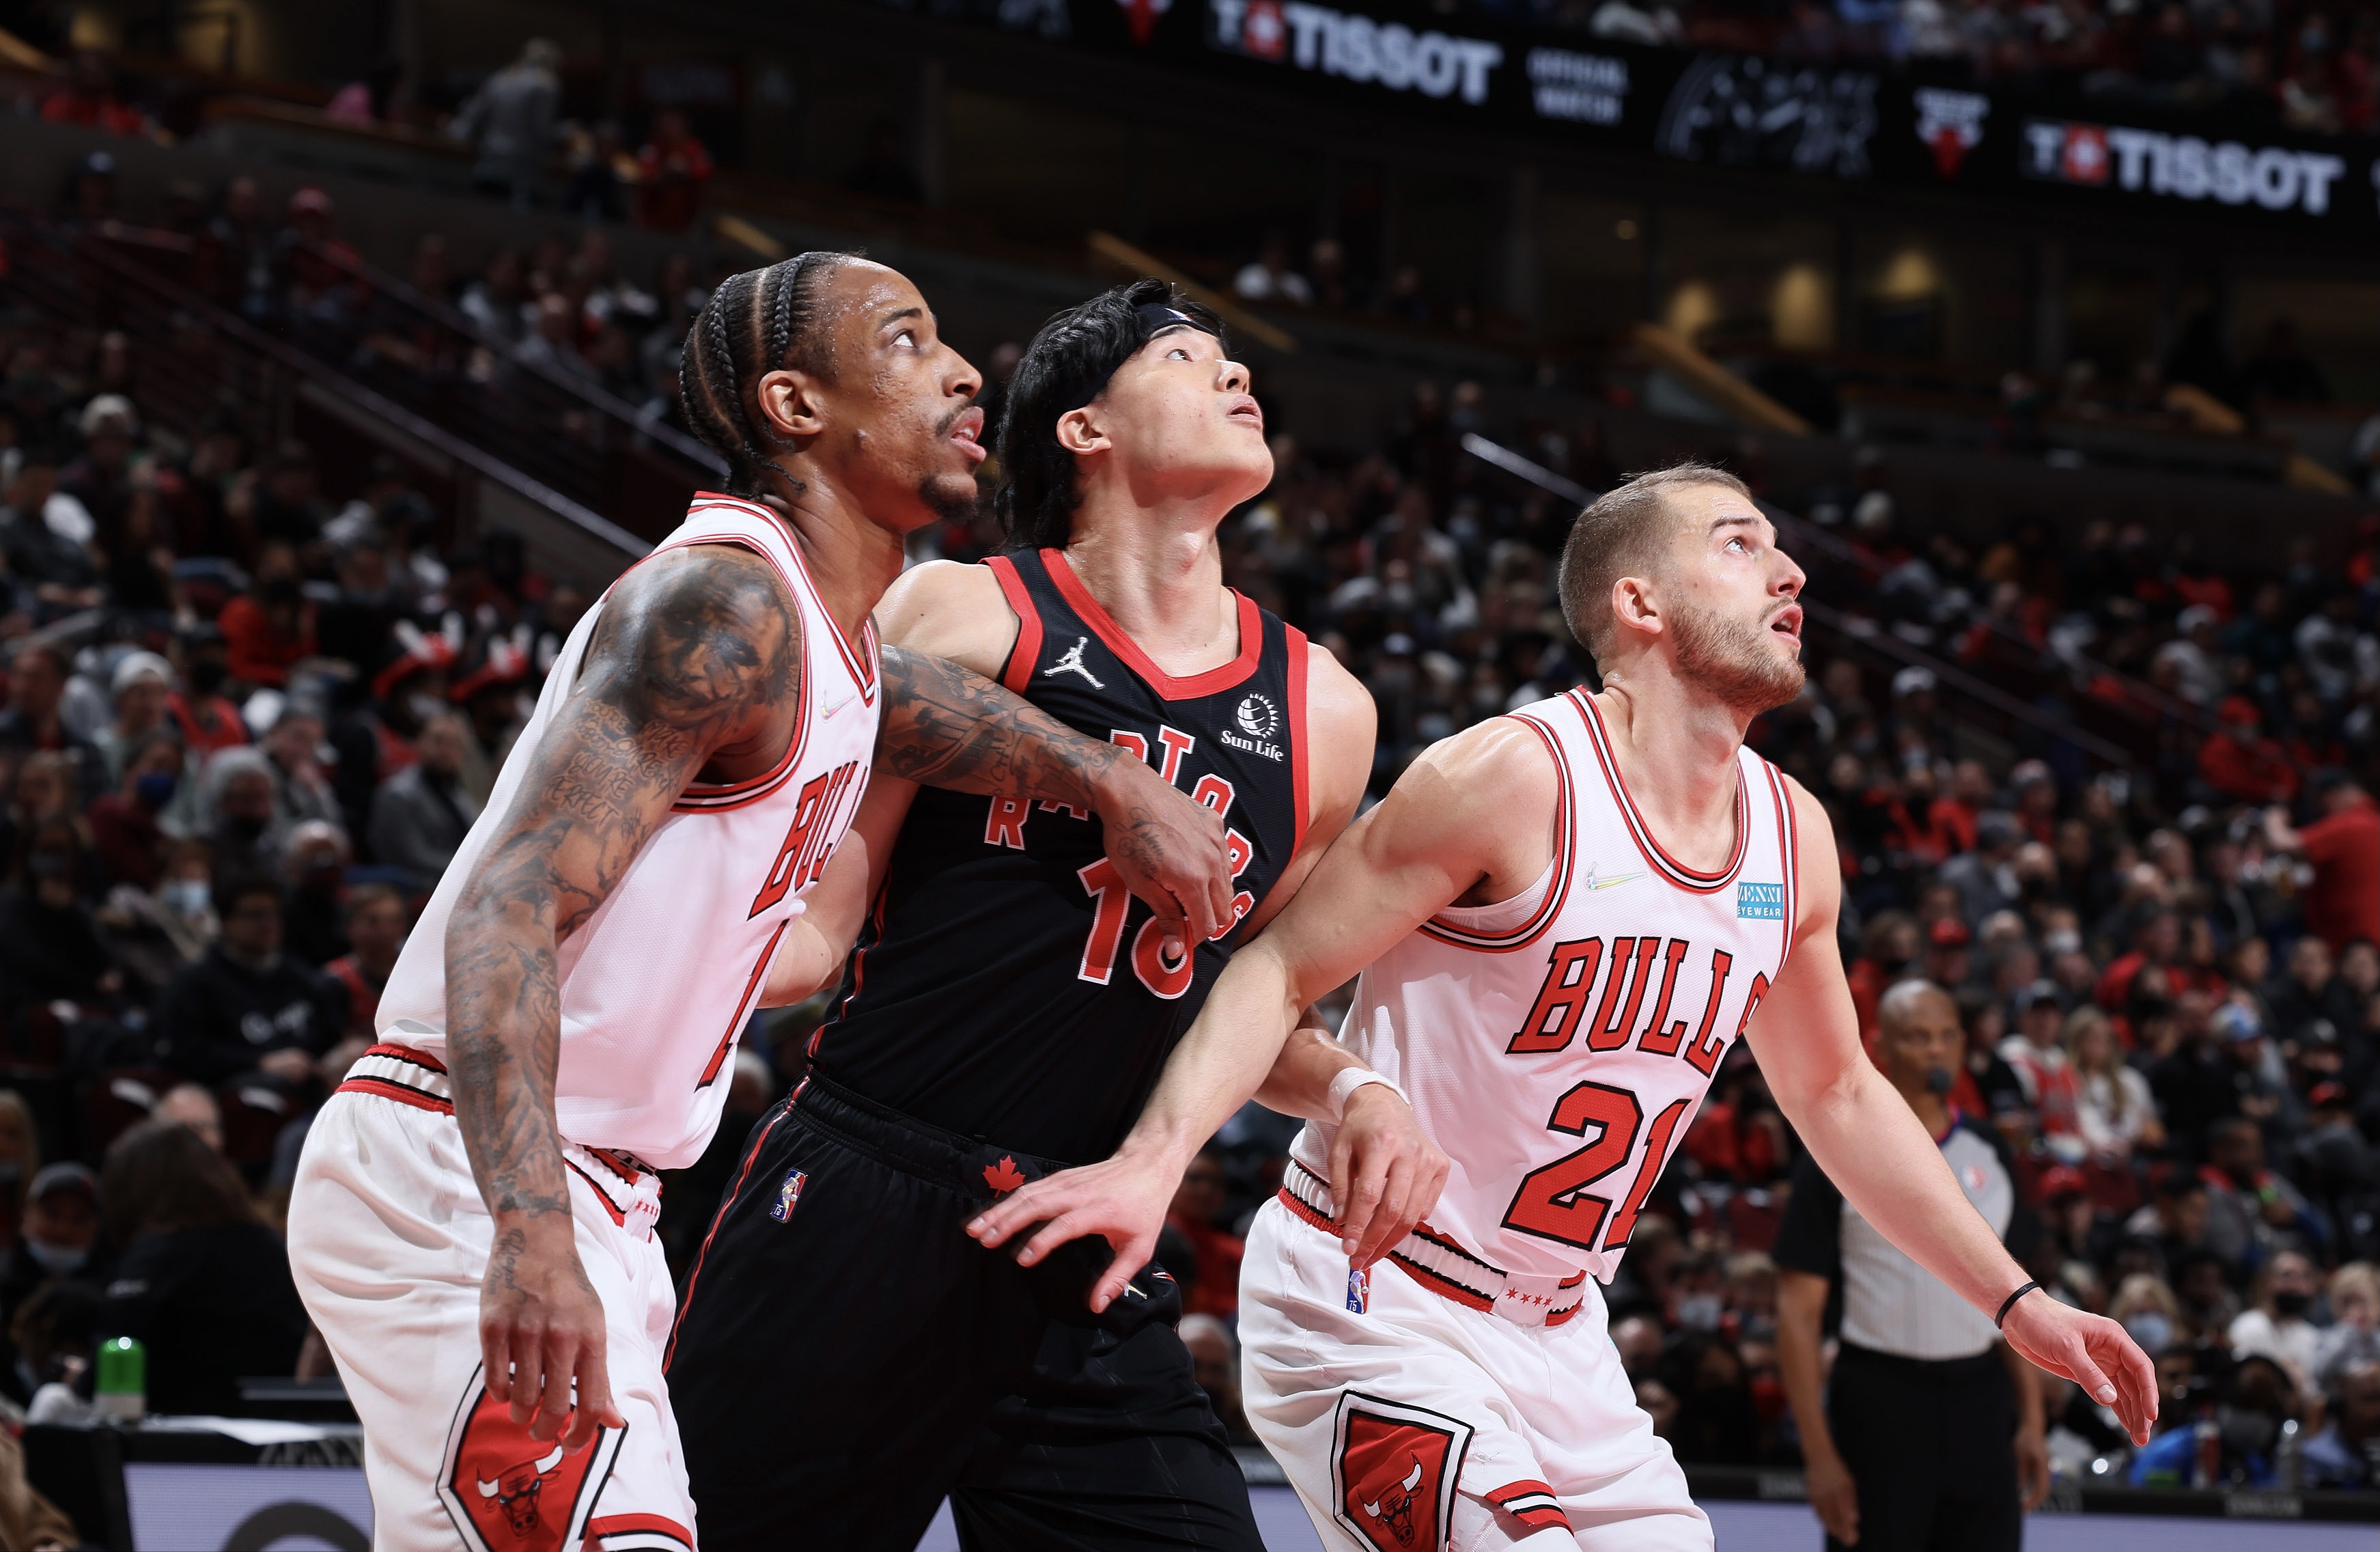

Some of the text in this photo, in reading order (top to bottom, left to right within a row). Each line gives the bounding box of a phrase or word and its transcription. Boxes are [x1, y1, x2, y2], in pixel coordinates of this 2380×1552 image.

[1285, 2, 1502, 105] TISSOT
[2110, 125, 2344, 216] TISSOT
[1221, 730, 1284, 762] Sun Life
[1738, 885, 1781, 903] ZENNI
[1738, 906, 1780, 917] EYEWEAR
[1500, 1079, 1692, 1253] 21
[1349, 1300, 1358, 1312] 75
